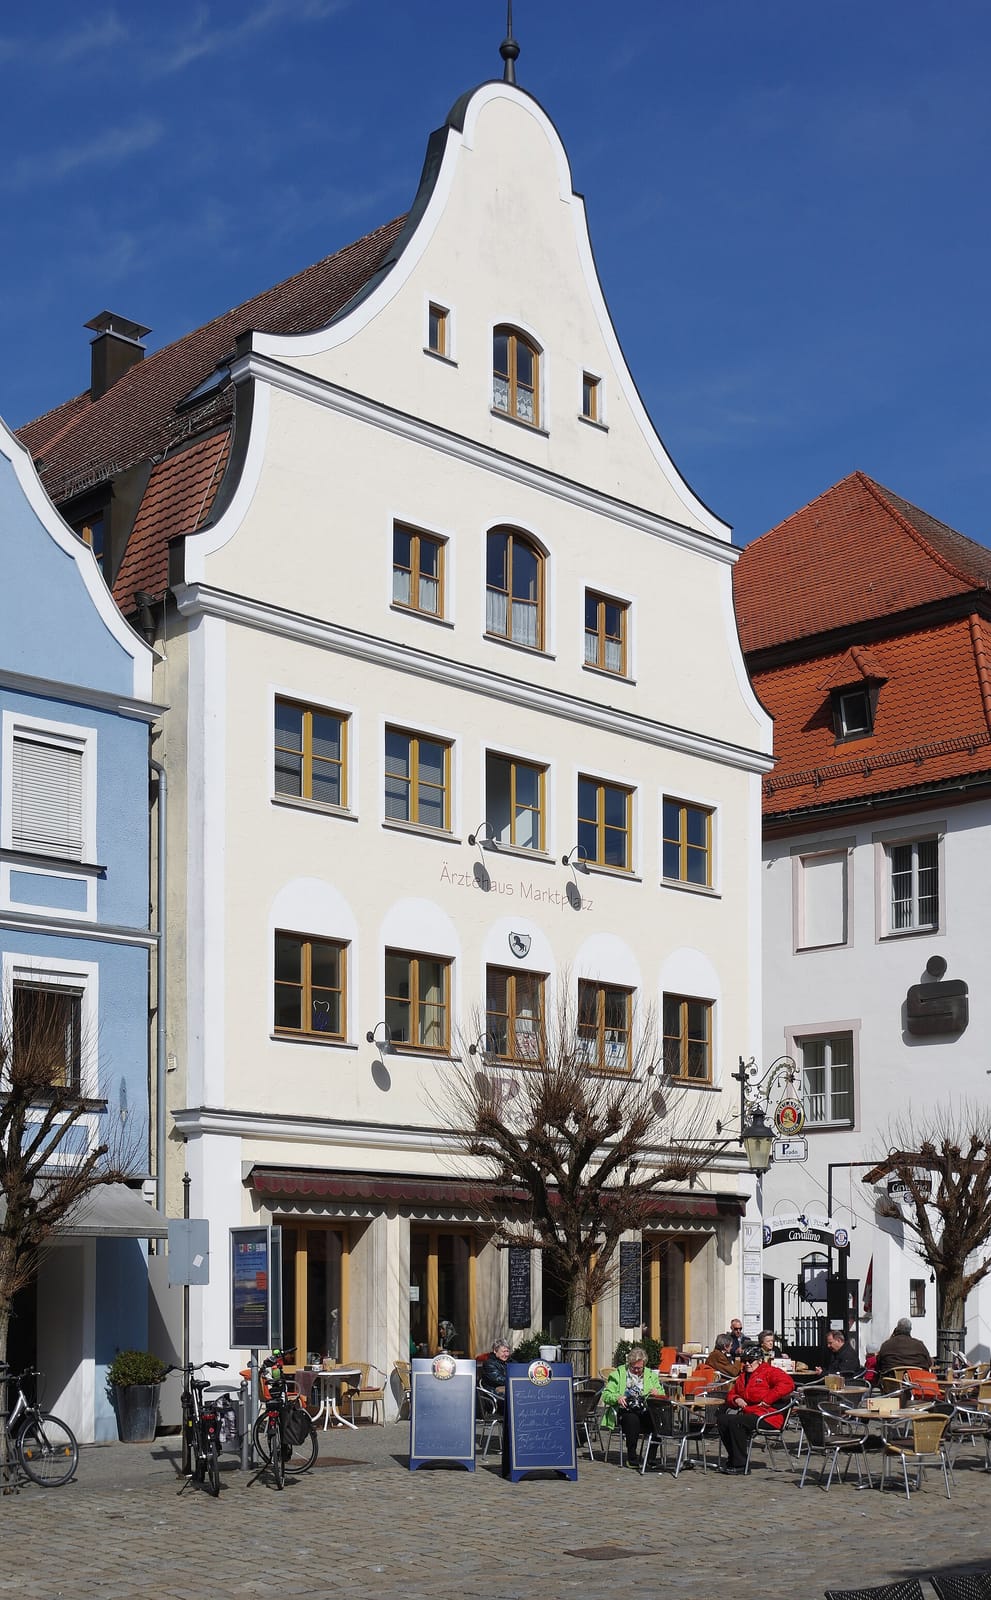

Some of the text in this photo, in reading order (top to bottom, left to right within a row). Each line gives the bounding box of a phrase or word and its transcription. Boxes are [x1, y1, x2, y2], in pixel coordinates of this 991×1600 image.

[440, 861, 593, 911] Ärztehaus Marktplatz
[789, 1230, 821, 1241] Cavallino
